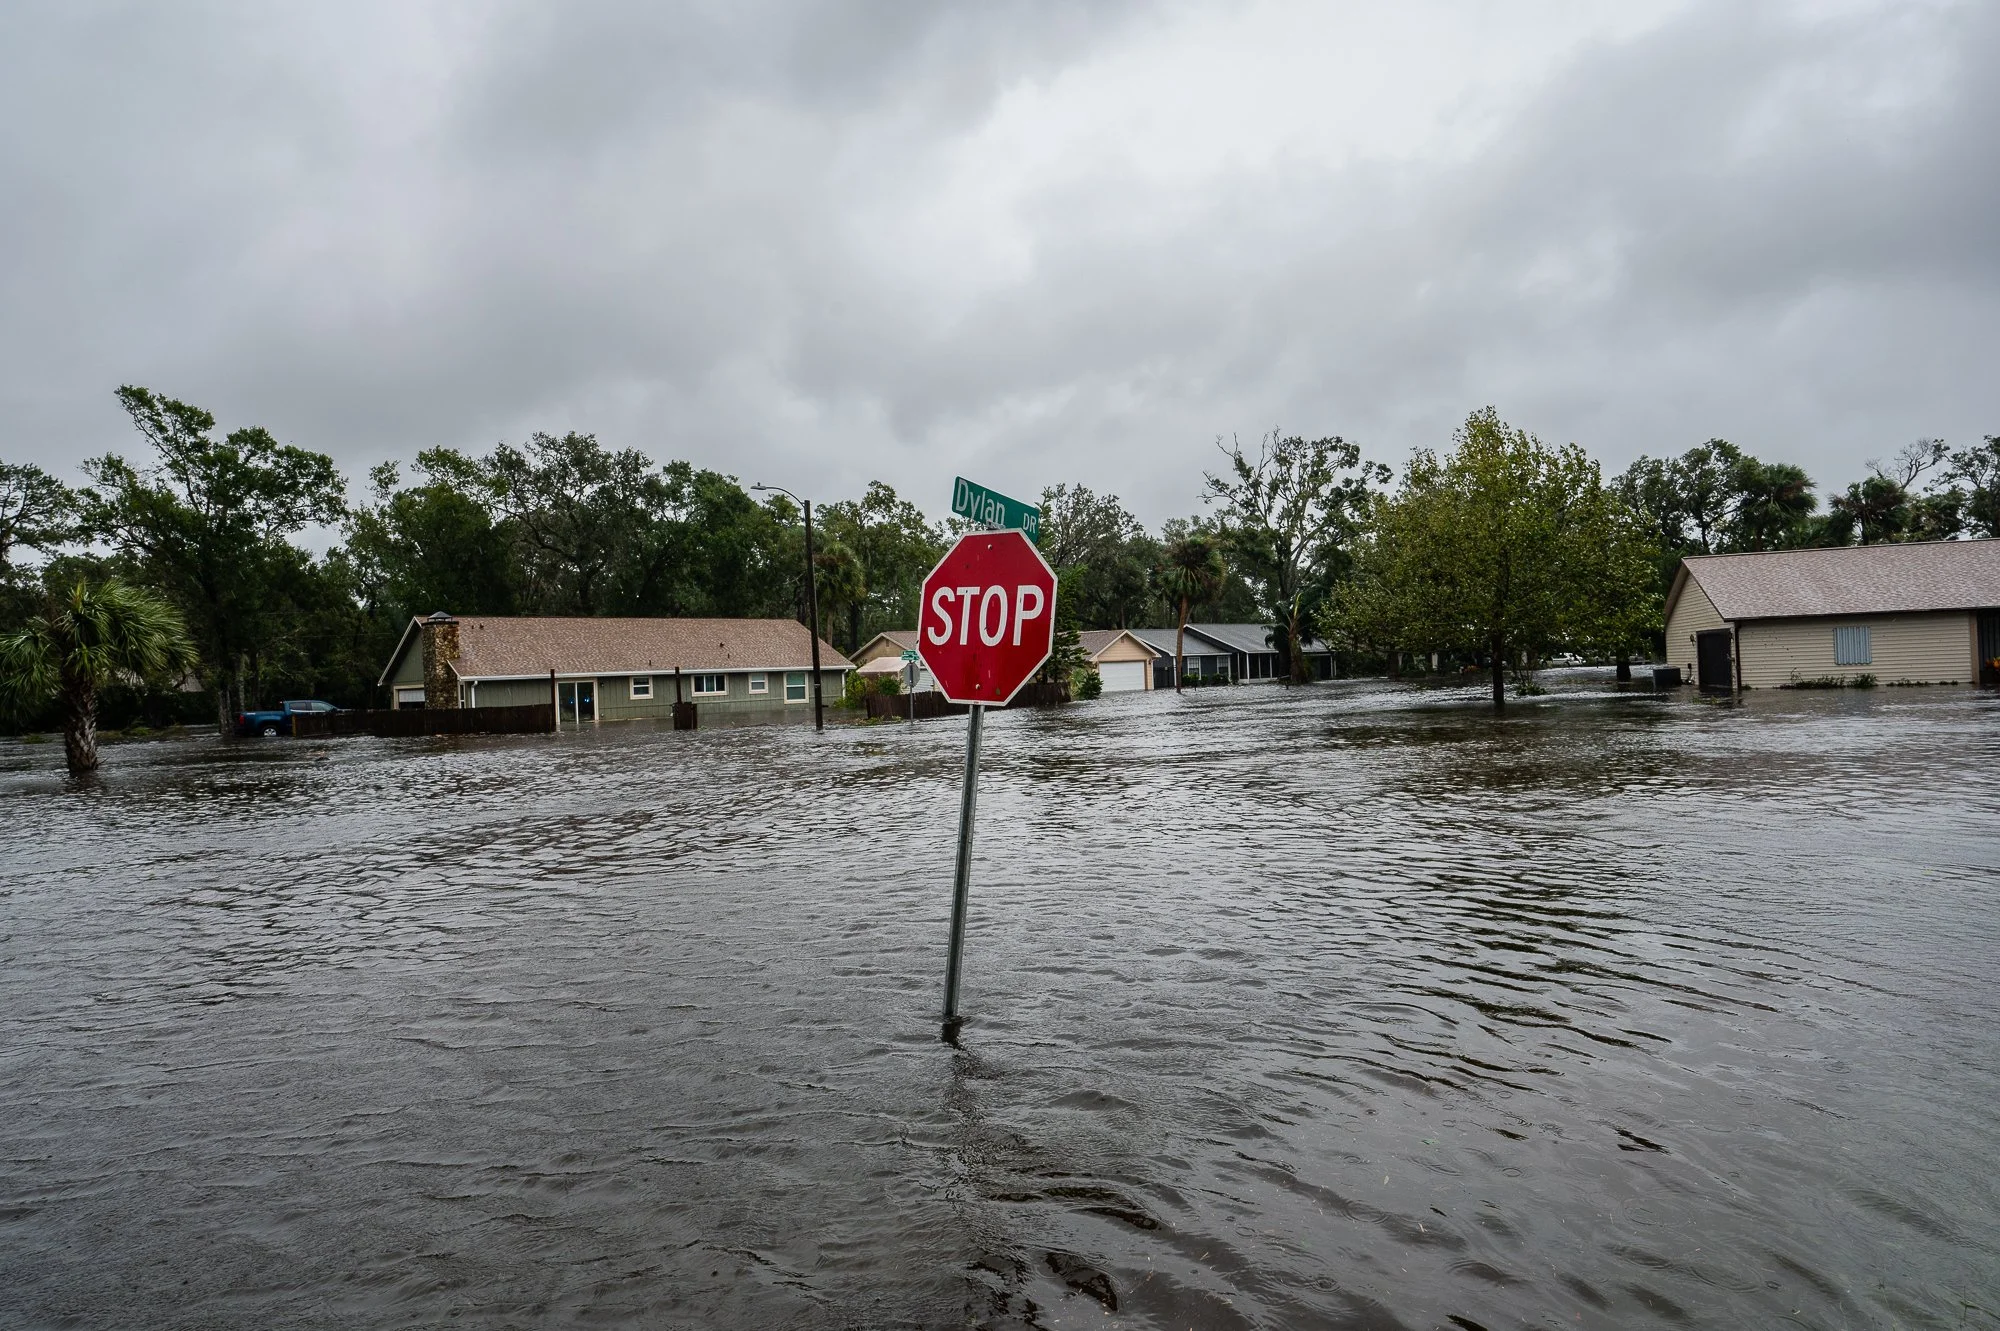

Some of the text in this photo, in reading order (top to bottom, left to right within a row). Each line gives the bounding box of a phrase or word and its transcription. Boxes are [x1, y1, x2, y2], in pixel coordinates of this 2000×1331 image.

[956, 479, 1037, 534] Dylan DR
[927, 585, 1045, 647] STOP
